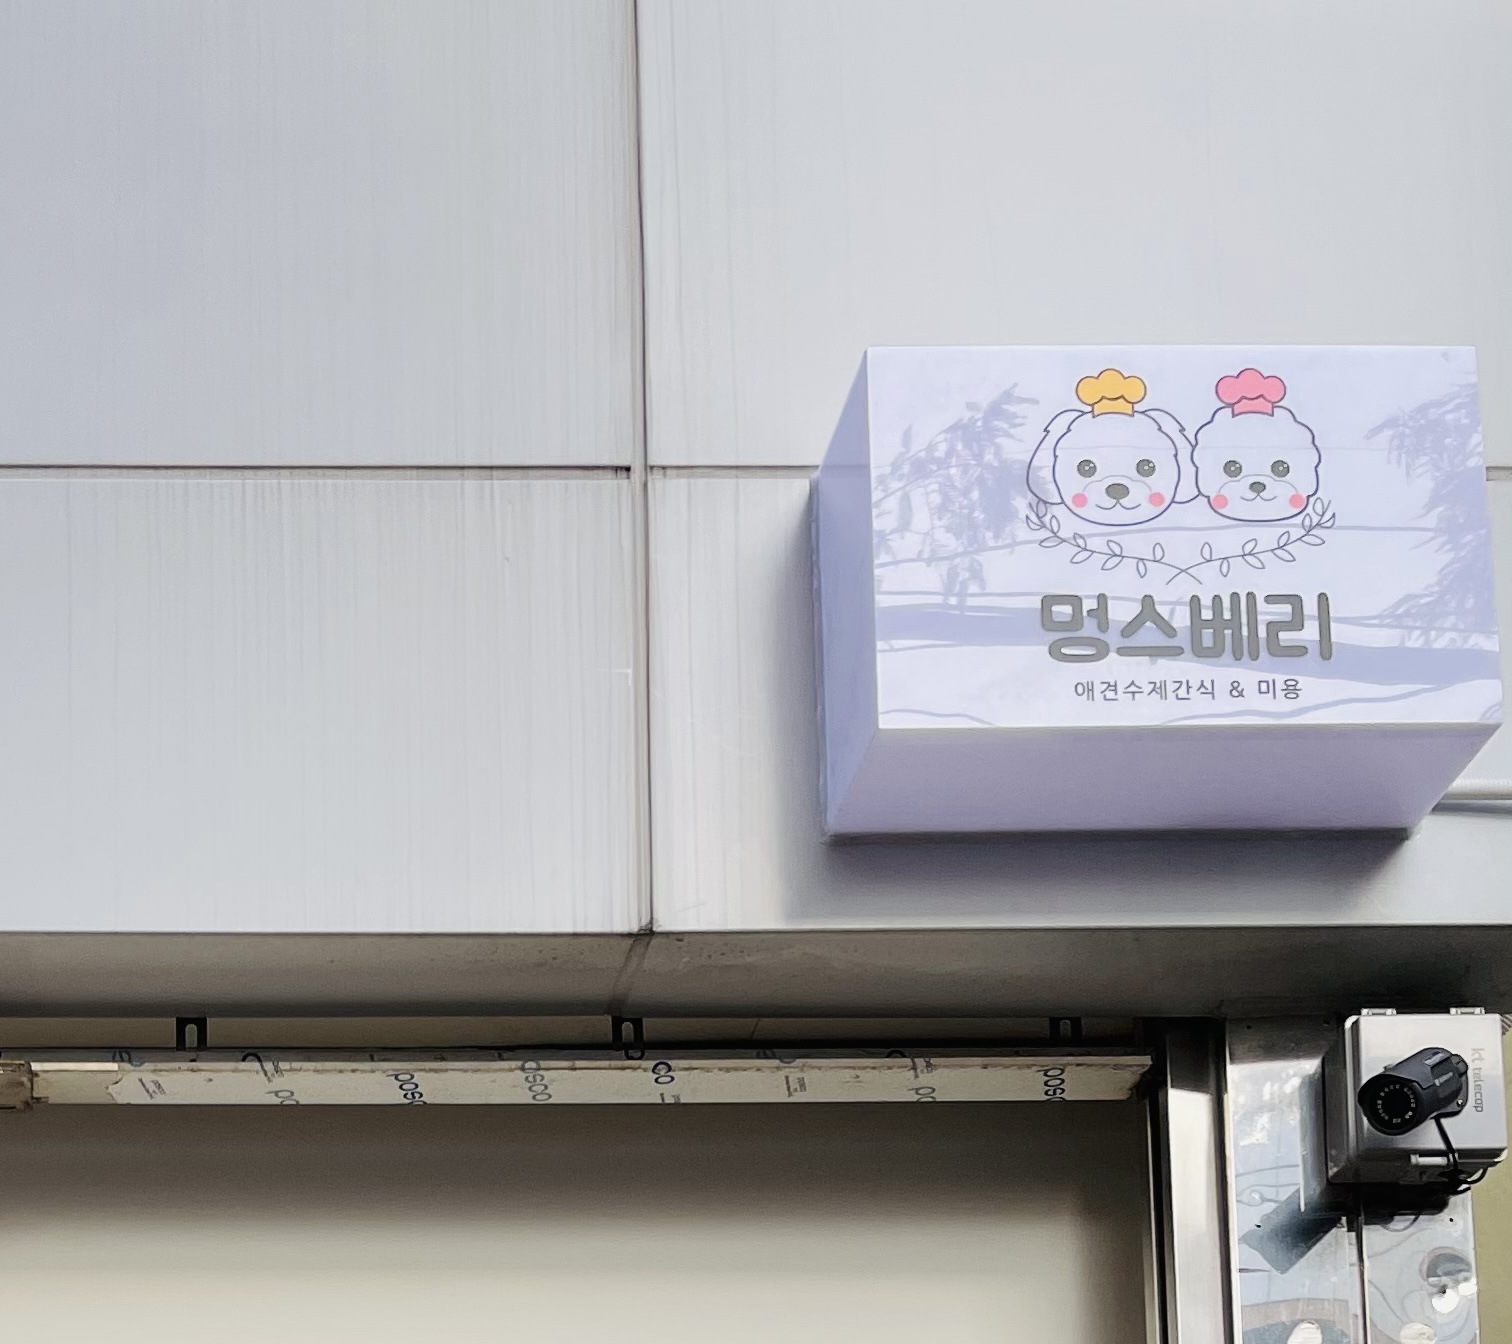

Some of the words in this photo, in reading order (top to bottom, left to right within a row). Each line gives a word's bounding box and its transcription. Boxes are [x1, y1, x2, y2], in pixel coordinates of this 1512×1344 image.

[1040, 591, 1332, 663] 멍스베리
[1074, 679, 1216, 701] 애견수제간식
[1229, 680, 1245, 698] &
[1257, 678, 1302, 700] 미용
